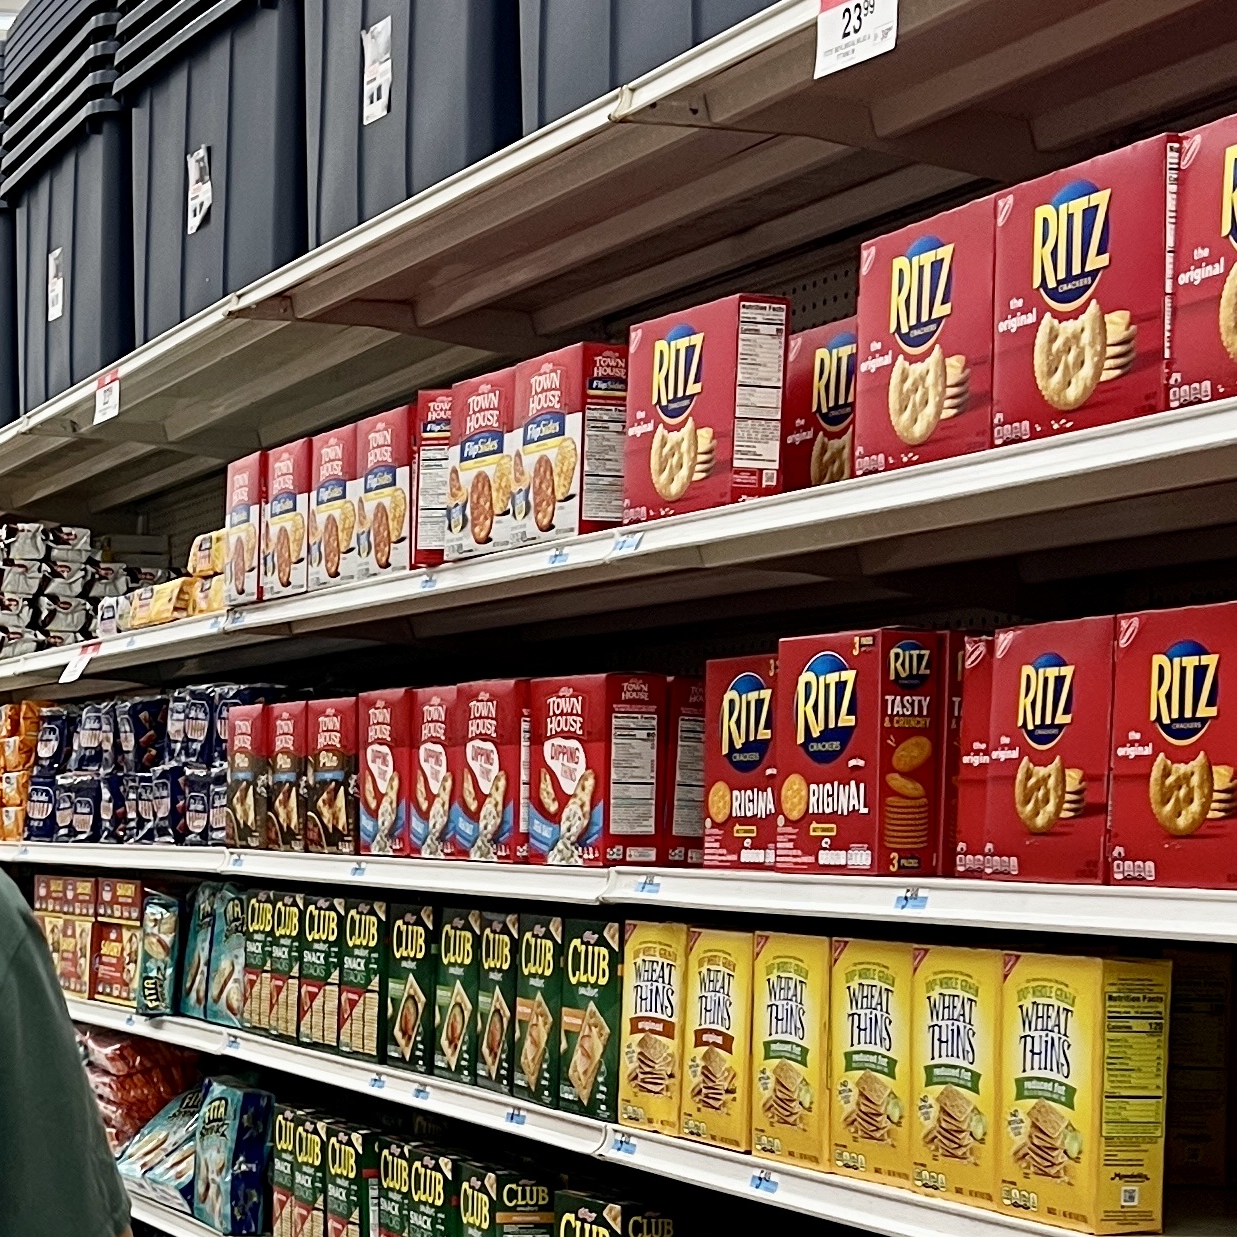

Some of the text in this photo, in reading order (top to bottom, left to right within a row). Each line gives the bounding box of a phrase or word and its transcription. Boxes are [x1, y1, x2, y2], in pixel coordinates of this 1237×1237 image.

[1032, 188, 1112, 290] RITZ
[889, 243, 955, 333] RITZ
[1178, 258, 1225, 287] original
[998, 307, 1037, 333] original
[593, 355, 626, 368] TOWN
[593, 366, 627, 379] HOUSE
[652, 332, 704, 405] RITZ
[860, 350, 893, 373] original
[530, 370, 561, 395] TOWN
[468, 390, 499, 415] TOWN
[528, 390, 561, 416] HOUSE
[466, 410, 499, 435] HOUSE
[527, 420, 559, 440] FlipSides
[464, 437, 498, 457] FlipSides
[889, 648, 931, 680] RITZ
[1017, 664, 1075, 730] RITZ
[1150, 653, 1220, 725] RITZ
[422, 704, 447, 722] TOWN
[469, 700, 497, 719] TOWN
[547, 695, 583, 716] TOWN
[797, 669, 857, 745] RITZ
[884, 696, 931, 716] TASTY
[421, 722, 447, 740] HOUSE
[468, 719, 497, 739] HOUSE
[546, 716, 584, 737] HOUSE
[722, 688, 773, 756] RITZ
[1116, 743, 1153, 758] original
[306, 904, 338, 942] CLUB
[346, 908, 378, 947] CLUB
[393, 919, 426, 959] CLUB
[441, 923, 473, 966] CLUB
[482, 927, 511, 970] CLUB
[522, 931, 554, 976] CLUB
[567, 937, 610, 986] CLUB
[633, 959, 676, 986] WHEAT
[698, 968, 735, 998] WHEAT
[766, 974, 808, 1006] WHEAT
[846, 982, 894, 1016] WHEAT
[926, 992, 977, 1027] WHEAT
[1018, 1000, 1074, 1038] WHEAT
[295, 1126, 322, 1166] CLUB
[328, 1136, 356, 1179] CLUB
[380, 1149, 409, 1193] CLUB
[411, 1160, 445, 1206] CLUB
[460, 1181, 490, 1231] CLUB
[502, 1183, 549, 1207] CLUB
[409, 1210, 432, 1229] SNACK
